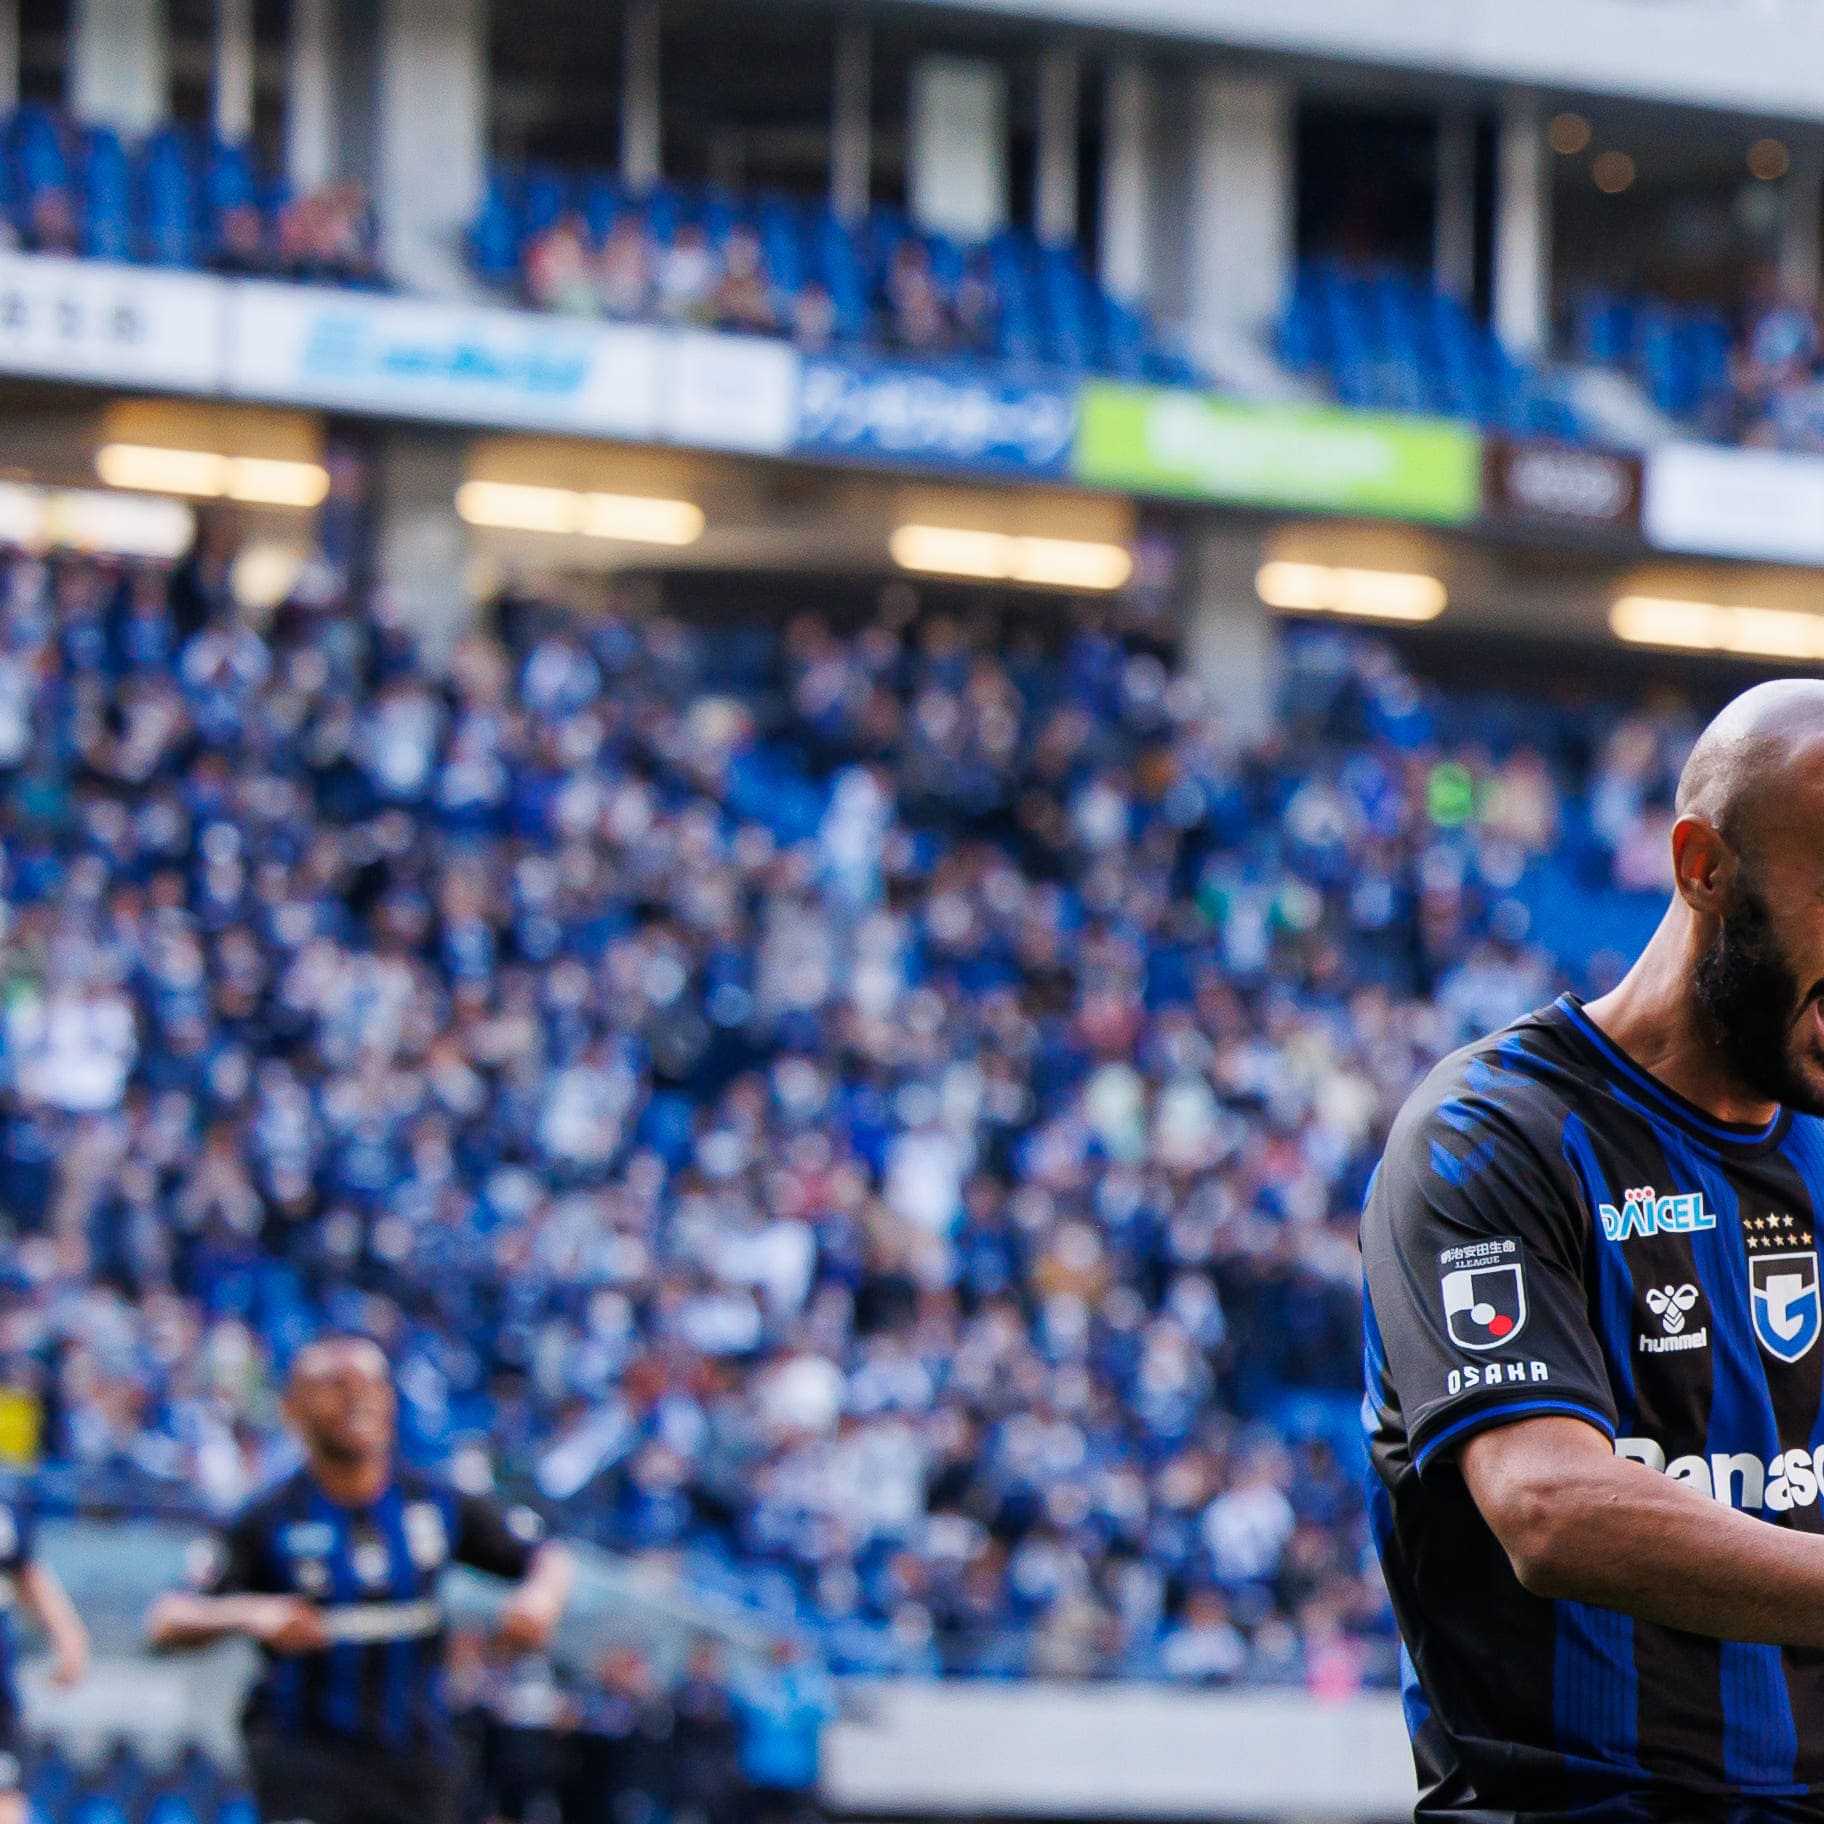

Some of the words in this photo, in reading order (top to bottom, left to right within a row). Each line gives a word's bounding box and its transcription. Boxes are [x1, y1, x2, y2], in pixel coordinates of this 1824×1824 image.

[1599, 1186, 1716, 1240] DAICEL
[1639, 1326, 1708, 1353] hummel
[1447, 1360, 1549, 1395] OSAKA
